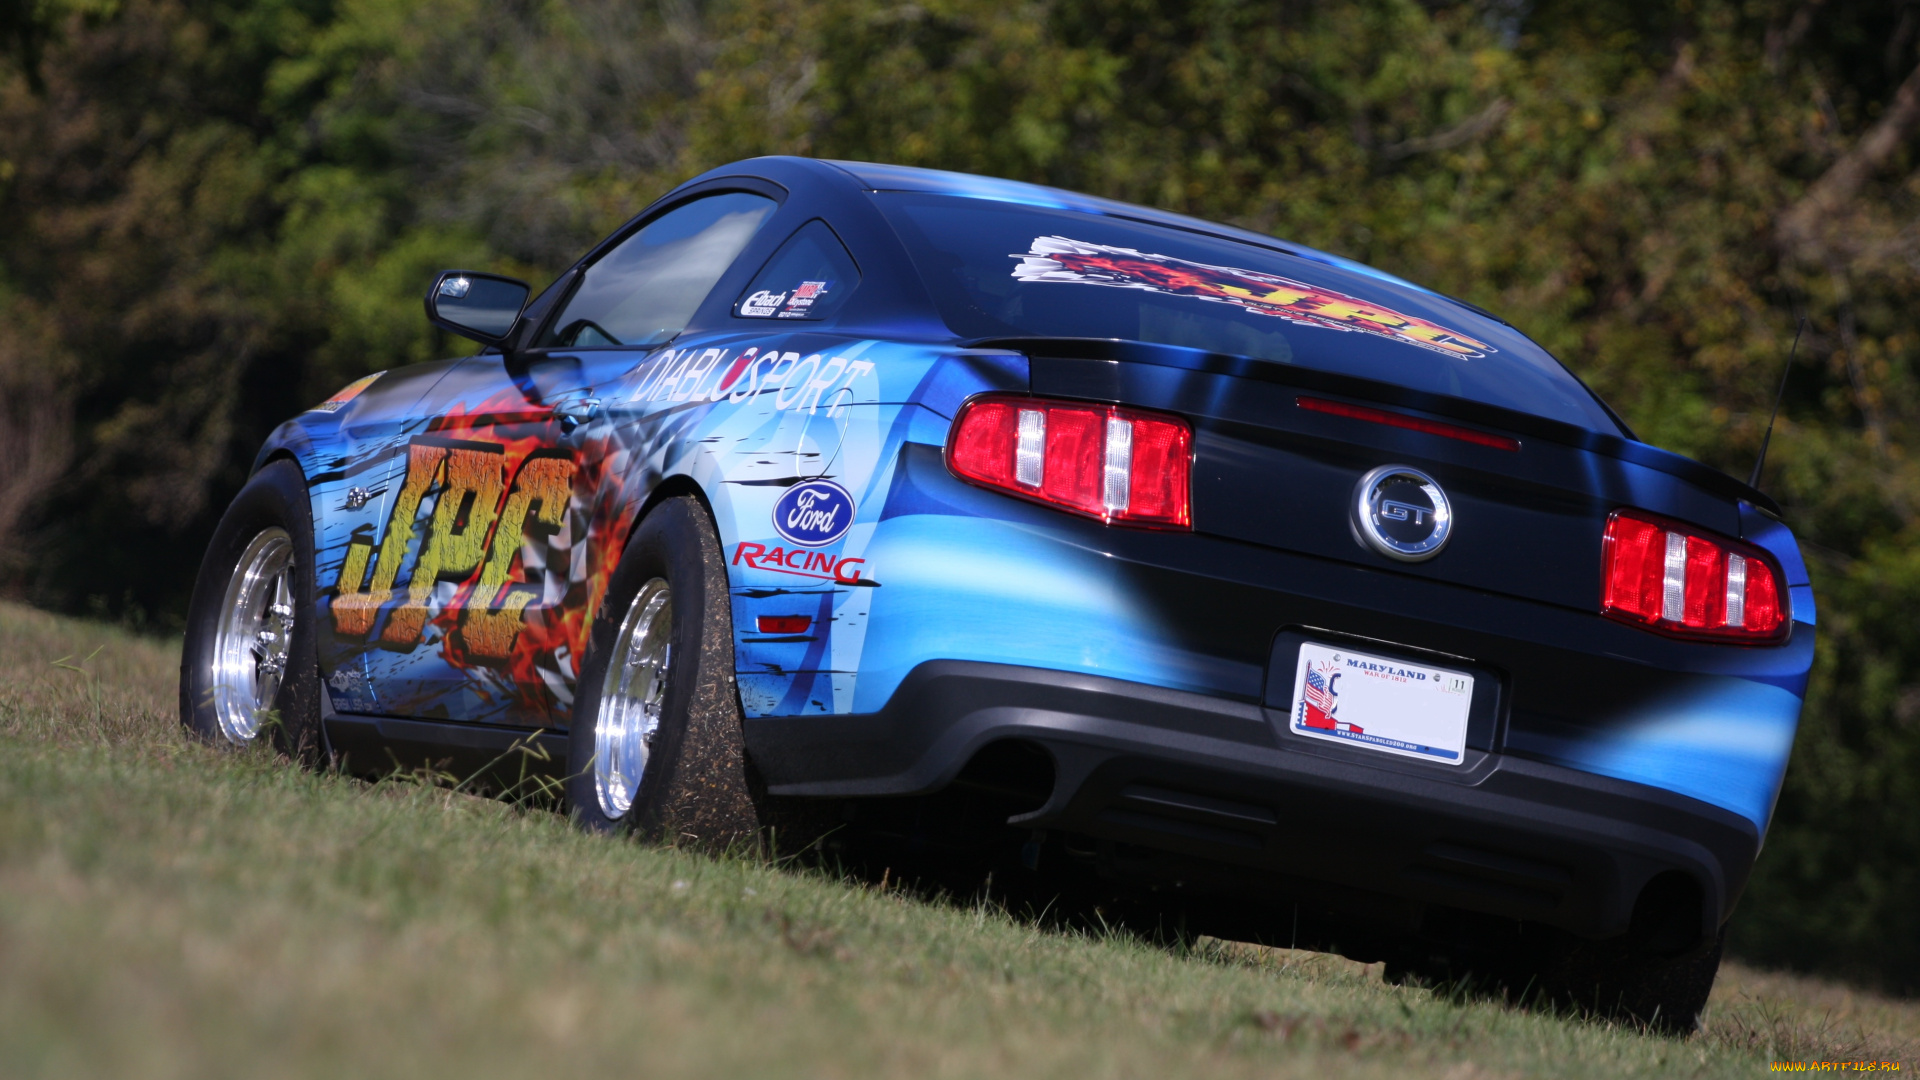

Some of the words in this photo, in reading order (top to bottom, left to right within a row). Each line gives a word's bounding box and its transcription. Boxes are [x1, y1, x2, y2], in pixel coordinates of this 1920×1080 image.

[632, 346, 876, 419] DIABLOSPORT
[787, 488, 840, 533] Ford
[1381, 499, 1434, 525] GT
[331, 438, 576, 660] JPC
[732, 542, 866, 584] RACING
[1346, 658, 1427, 681] MARYLAND
[1364, 670, 1380, 678] WAR
[1391, 675, 1408, 683] 1812
[1455, 679, 1465, 690] 11
